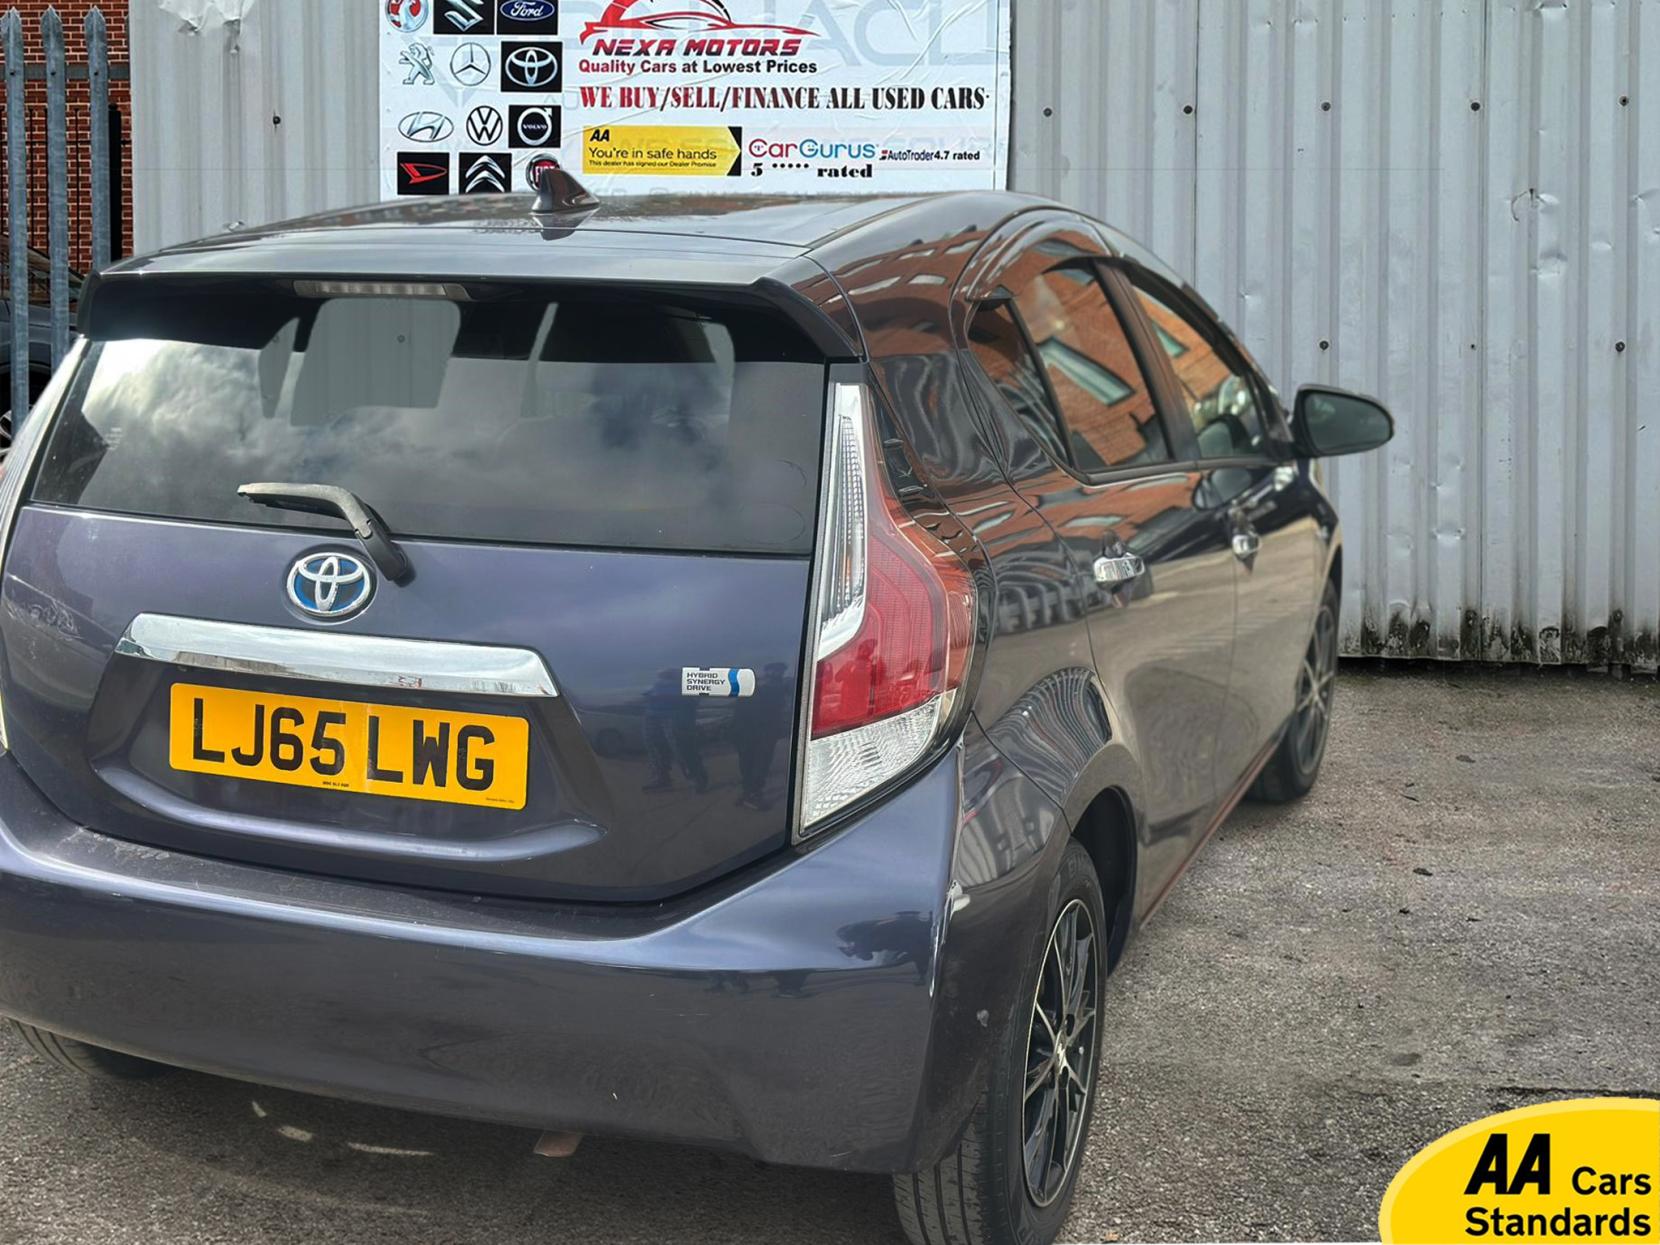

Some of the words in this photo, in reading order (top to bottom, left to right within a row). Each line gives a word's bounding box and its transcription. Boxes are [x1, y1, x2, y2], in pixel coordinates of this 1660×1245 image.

[510, 1, 543, 17] Ford
[592, 38, 673, 56] NEXA
[683, 38, 802, 56] MOTORS
[579, 59, 634, 74] Quality
[640, 59, 677, 73] Cars
[682, 60, 697, 73] at
[703, 60, 761, 73] Lowest
[766, 59, 818, 73] Prices
[580, 87, 612, 108] WE
[826, 87, 865, 109] ALL
[872, 87, 925, 109] USED
[589, 129, 611, 142] AA
[589, 147, 629, 159] You're
[632, 147, 642, 159] in
[647, 147, 673, 159] safe
[677, 148, 717, 160] hands
[748, 138, 876, 158] CarGurus
[953, 150, 980, 160] rated
[751, 163, 763, 177] 5
[817, 163, 873, 178] rated
[192, 698, 347, 776] LJ65
[366, 715, 495, 791] LWG
